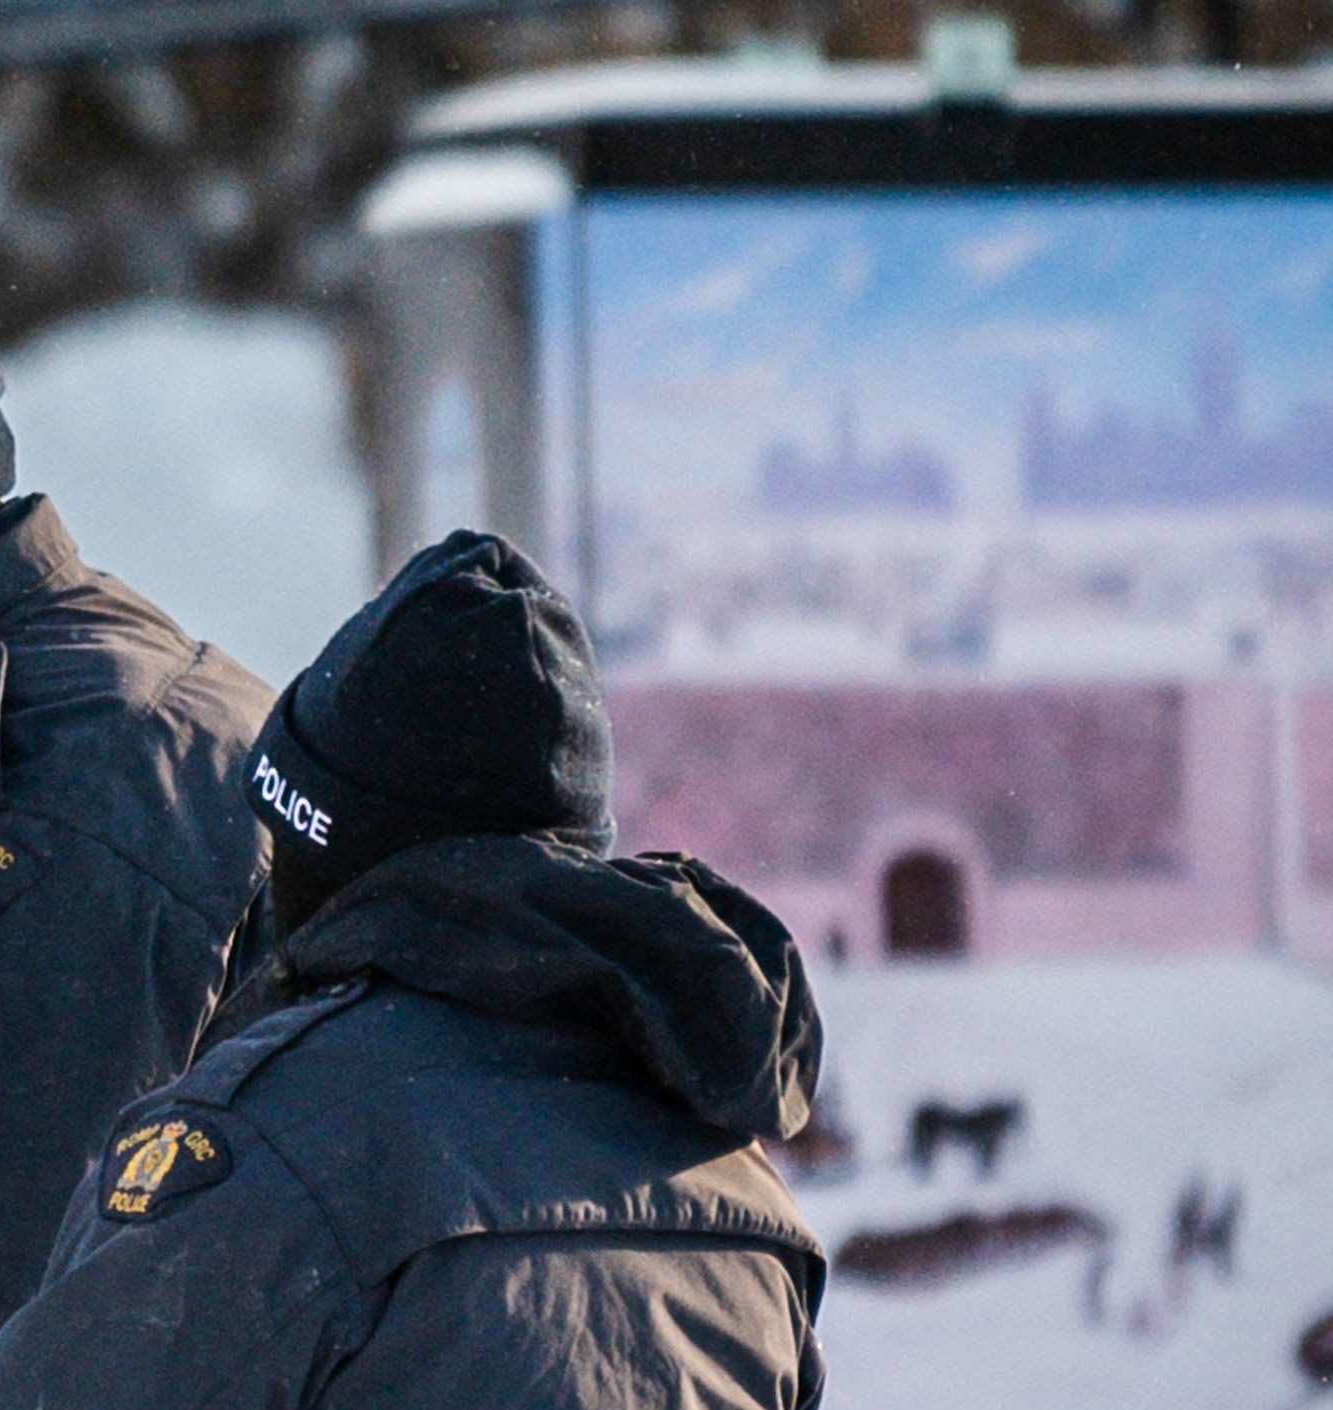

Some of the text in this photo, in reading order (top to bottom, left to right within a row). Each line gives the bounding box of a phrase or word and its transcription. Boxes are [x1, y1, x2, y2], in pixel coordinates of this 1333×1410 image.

[252, 753, 333, 847] POLICE
[183, 1130, 216, 1162] GRC
[107, 1190, 152, 1213] POLICE
